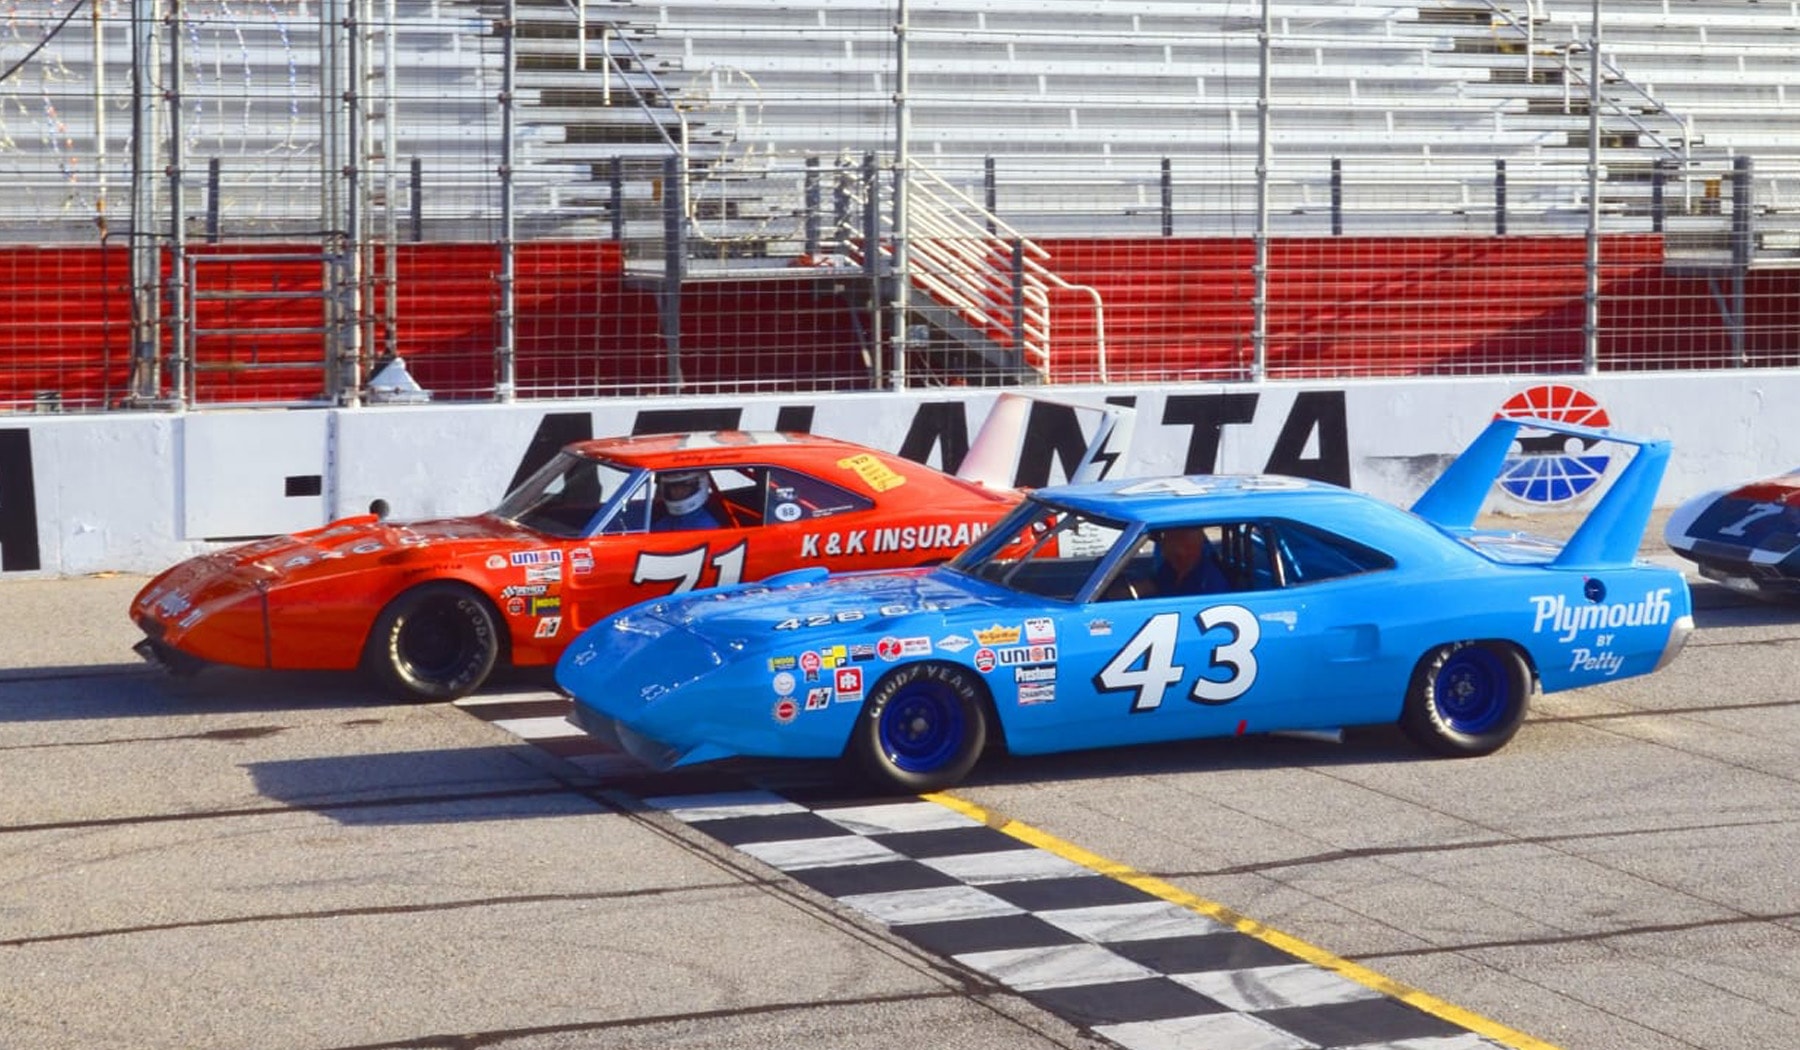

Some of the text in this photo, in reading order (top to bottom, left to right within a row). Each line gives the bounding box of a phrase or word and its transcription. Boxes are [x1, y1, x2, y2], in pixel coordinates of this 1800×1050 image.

[502, 390, 1350, 502] AANTA
[631, 537, 748, 596] 71
[801, 521, 989, 558] K & K INSURAN
[1529, 588, 1672, 643] Plymouth
[1596, 634, 1615, 647] BY
[1093, 604, 1261, 713] 43
[1569, 649, 1625, 676] Petty
